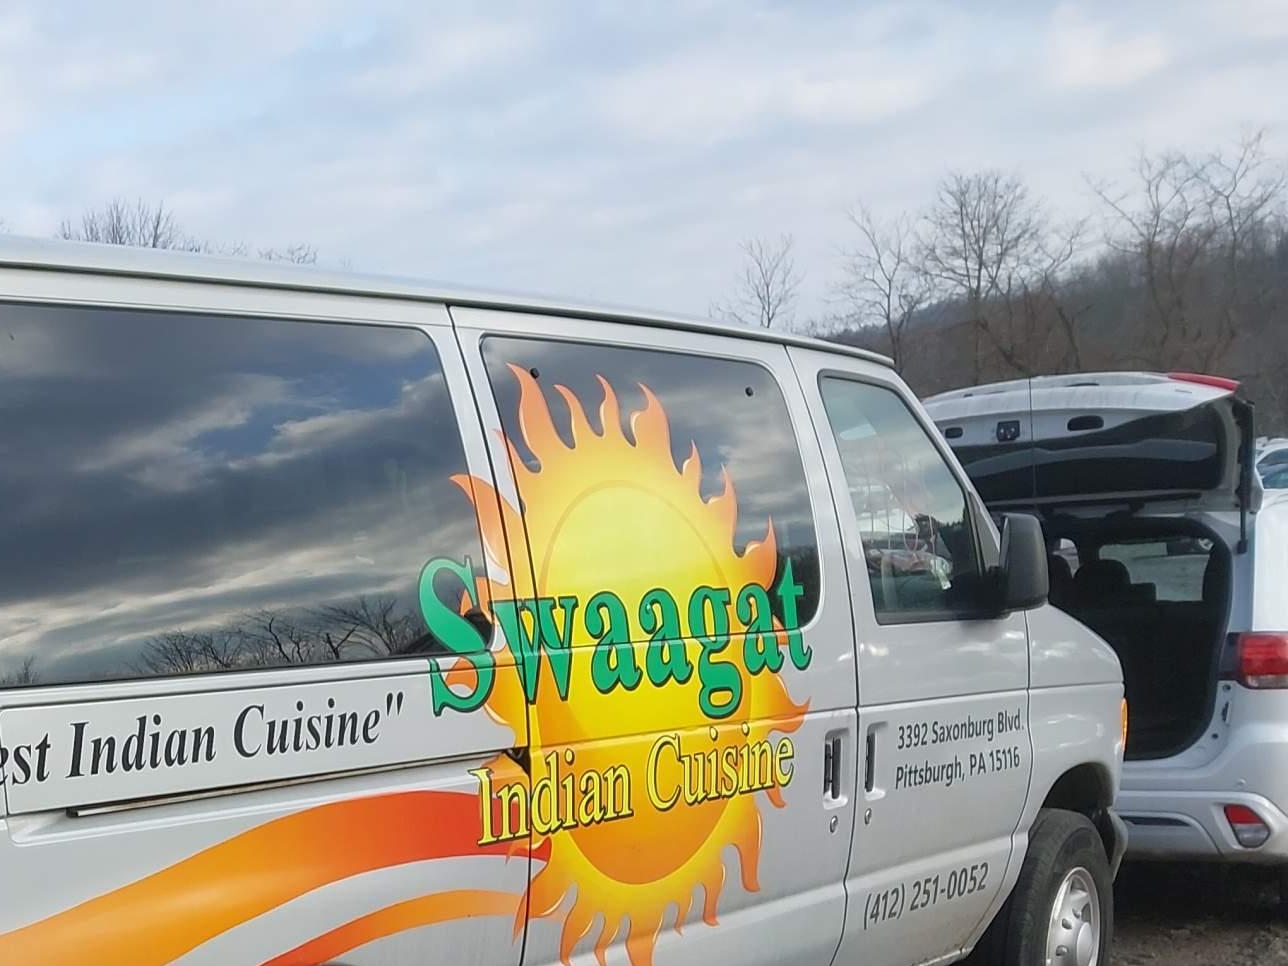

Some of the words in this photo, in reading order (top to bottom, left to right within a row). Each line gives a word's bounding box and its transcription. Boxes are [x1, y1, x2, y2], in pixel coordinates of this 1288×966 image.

[417, 554, 813, 719] Swaagat
[65, 713, 217, 779] Indian
[233, 691, 405, 758] Cuisine"
[895, 756, 965, 790] Pittsburgh,
[969, 752, 987, 777] PA
[988, 746, 1020, 773] 15116
[897, 722, 928, 750] 3392
[931, 715, 994, 745] Saxonburg
[997, 708, 1024, 734] Blvd.
[467, 747, 634, 846] Indian
[646, 722, 795, 812] Cuisine
[863, 883, 905, 930] (412)
[909, 862, 989, 912] 251-0052
